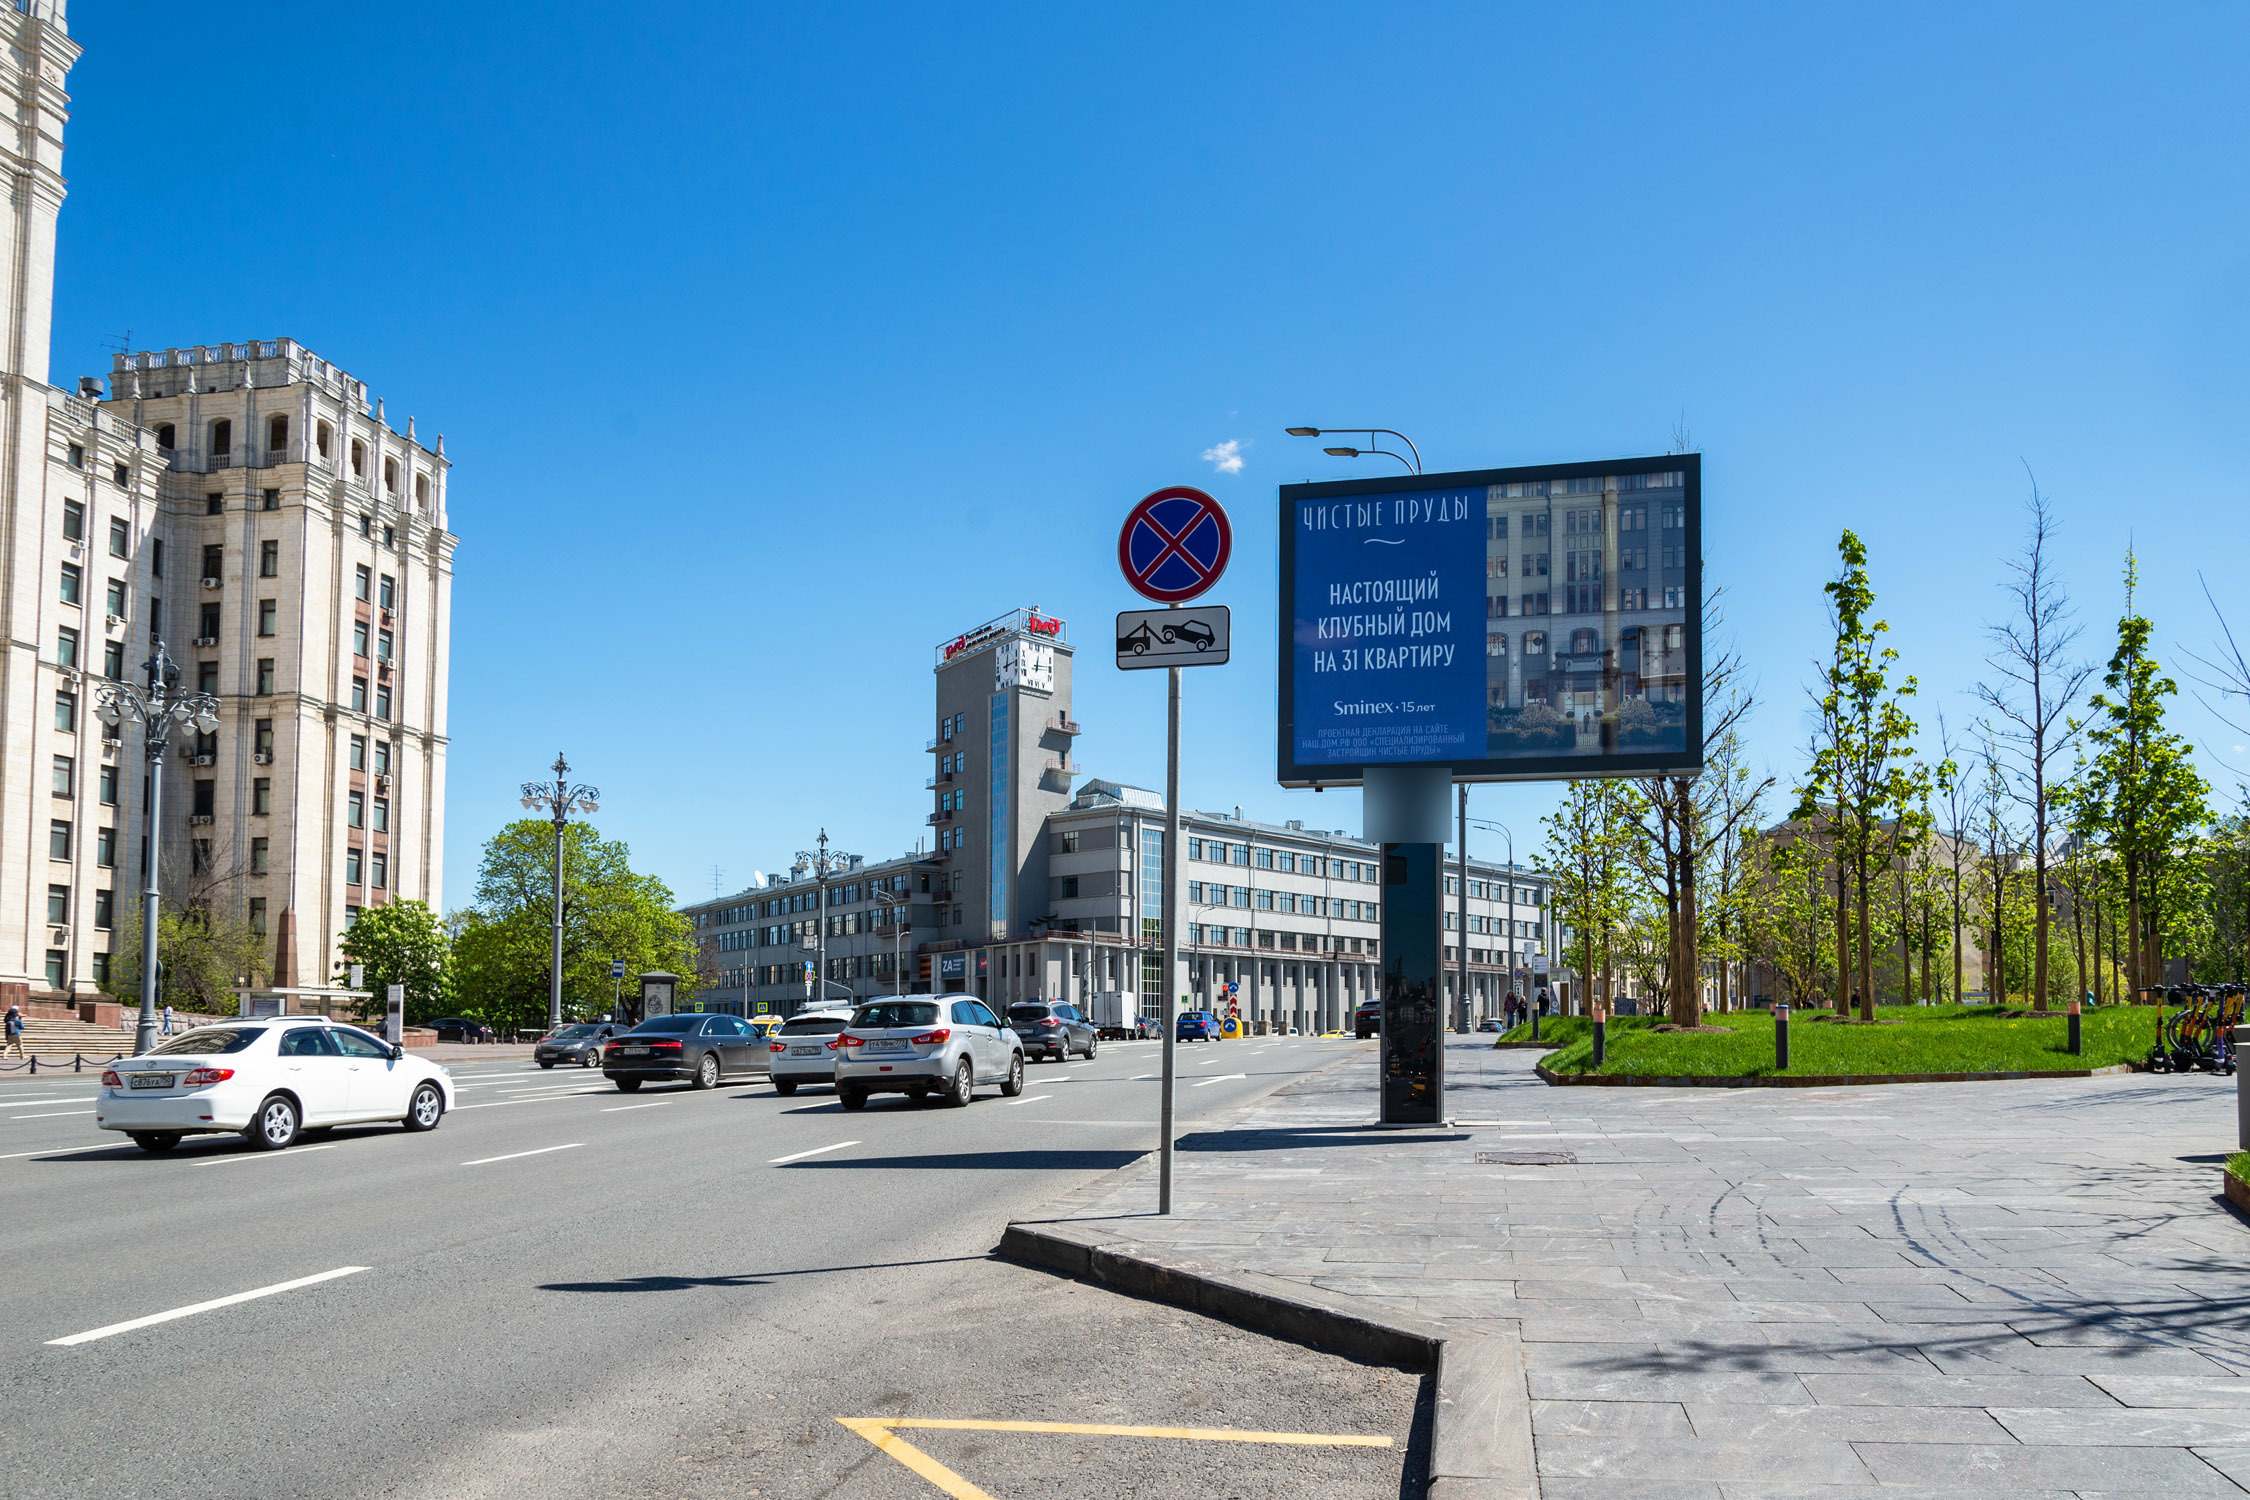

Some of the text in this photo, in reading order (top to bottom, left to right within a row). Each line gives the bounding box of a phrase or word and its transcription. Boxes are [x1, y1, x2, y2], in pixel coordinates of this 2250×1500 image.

[1303, 495, 1468, 531] ЧИСТЫЕ ПРУДЫ
[1330, 570, 1439, 605] НАСТОЯЩИЙ
[1318, 606, 1451, 639] КЛУБНЫЙ ДОМ
[1314, 644, 1456, 673] НА 31 КВАРТИРУ
[1334, 700, 1436, 716] Sminex 15 лет
[1318, 723, 1449, 738] ПРОЕКТНАЯ ДЕКЛАРАЦИЯ НА САЙТЕ
[1327, 747, 1376, 758] ЗАСТРОЙЩИК
[1379, 746, 1408, 756] ЧИСТЫЕ
[1352, 737, 1368, 747] ООО
